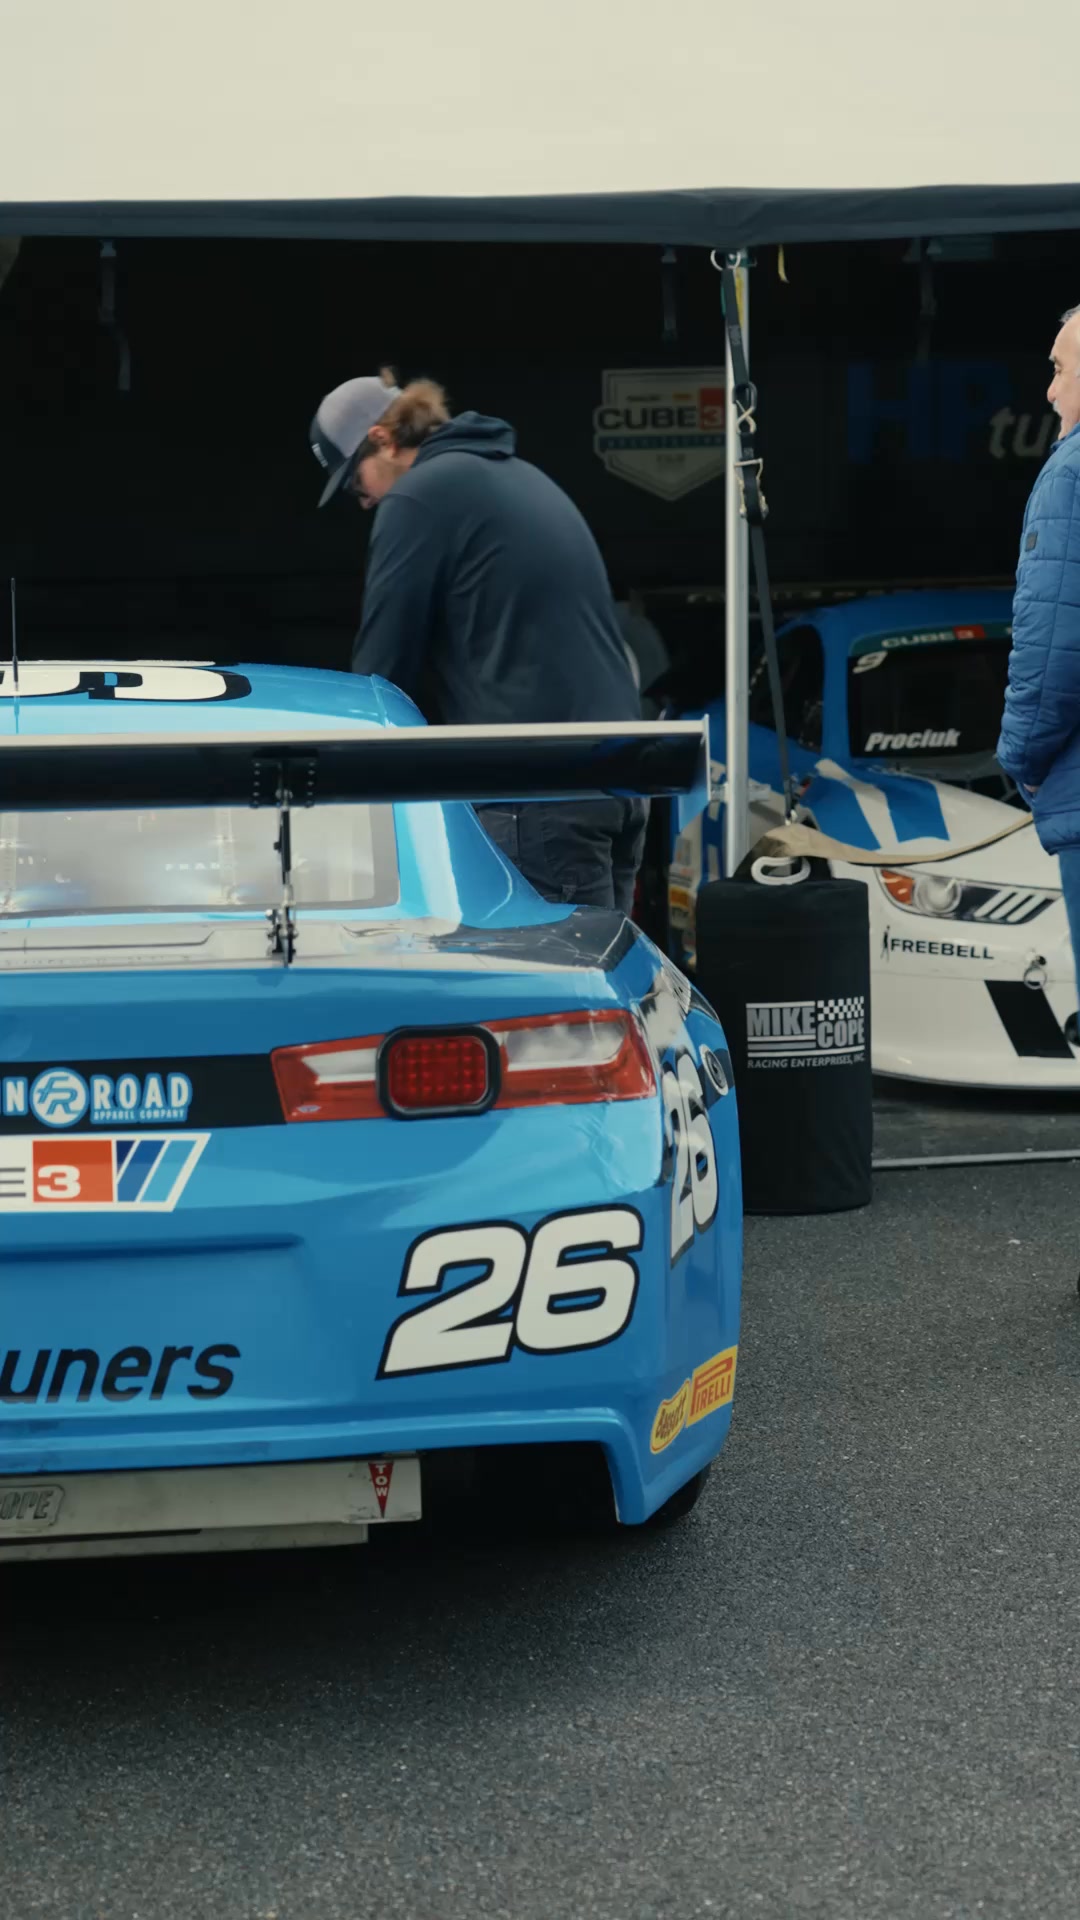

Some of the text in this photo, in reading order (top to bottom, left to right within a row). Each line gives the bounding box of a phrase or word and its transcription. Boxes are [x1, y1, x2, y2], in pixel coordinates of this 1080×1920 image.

[989, 407, 1059, 458] tu
[891, 938, 994, 960] FREEBELL
[746, 1006, 816, 1036] MIKE
[817, 1018, 865, 1048] COPE
[747, 1058, 788, 1069] RACING
[93, 1075, 190, 1110] ROAD
[139, 1108, 185, 1120] COMPANY
[377, 1206, 644, 1379] 26
[0, 1343, 242, 1404] uners
[689, 1356, 734, 1418] PIRELLI
[374, 1464, 389, 1497] TOW
